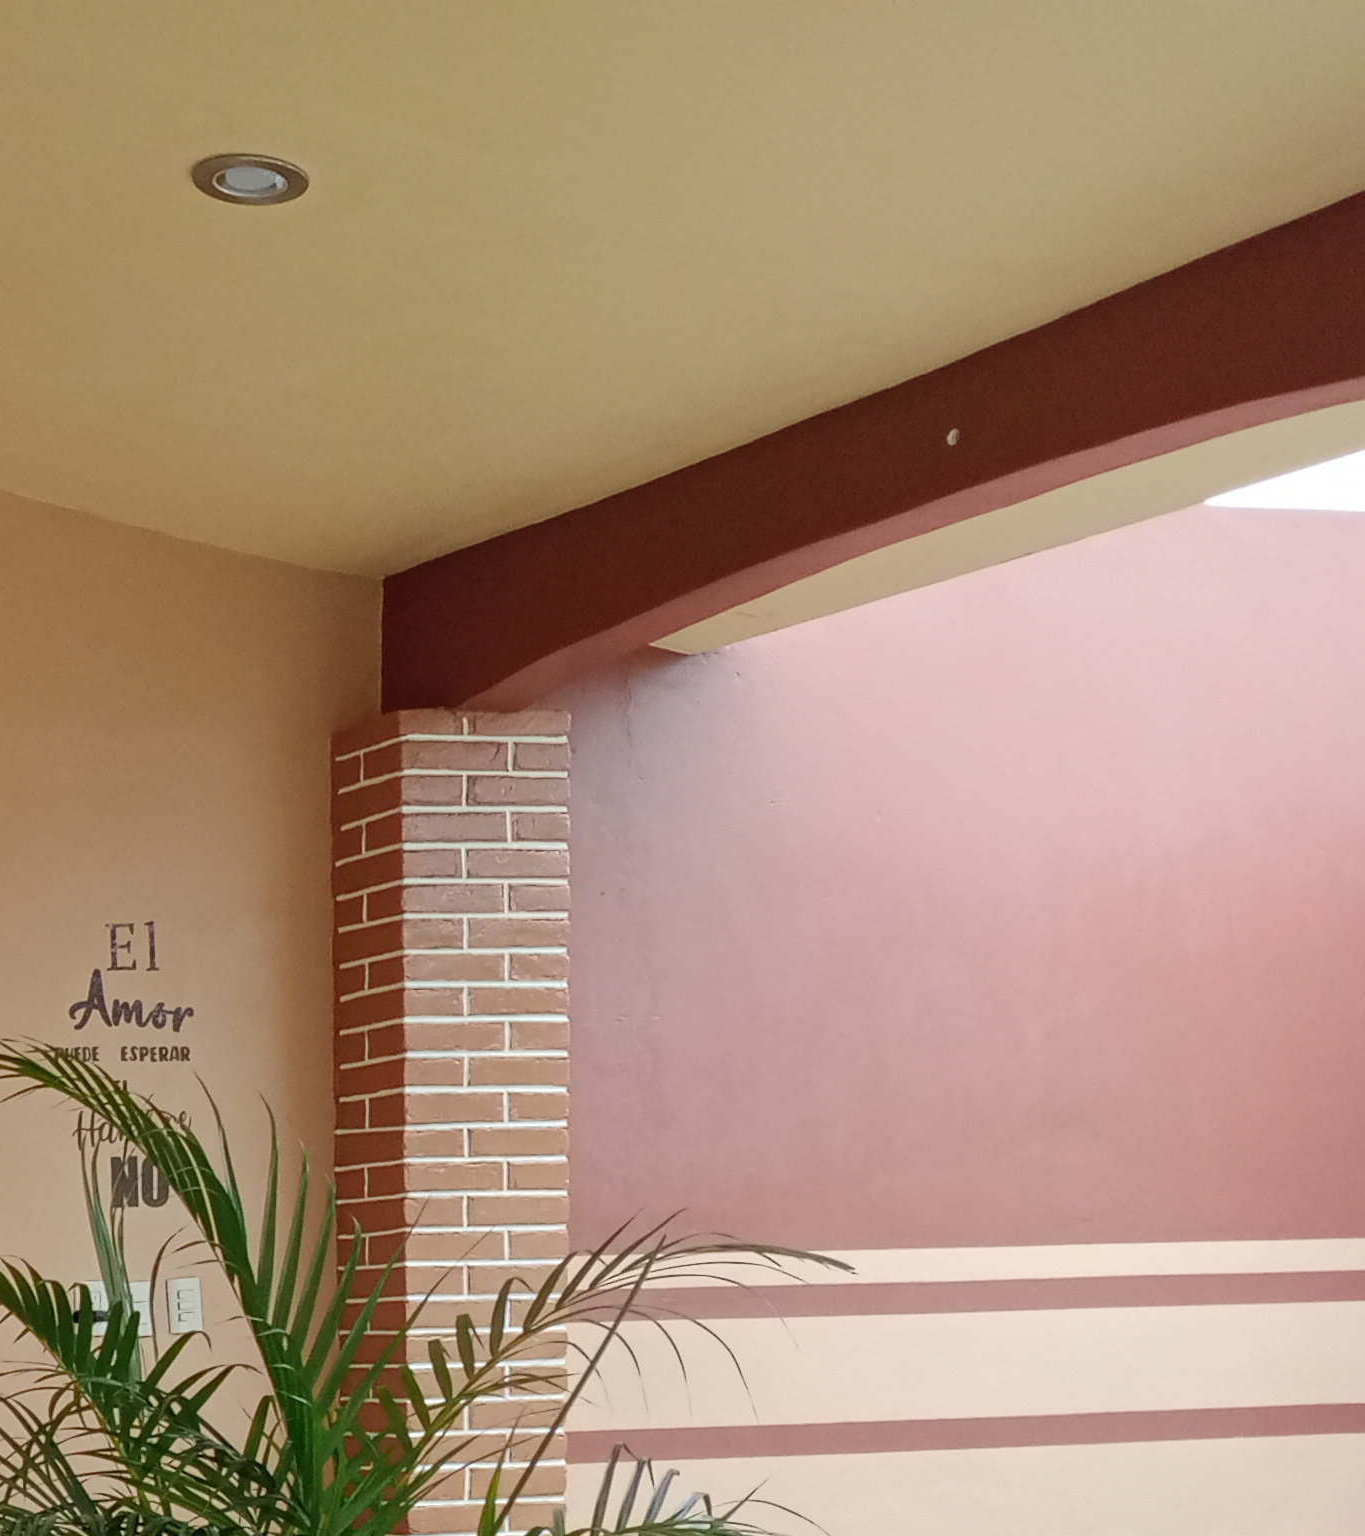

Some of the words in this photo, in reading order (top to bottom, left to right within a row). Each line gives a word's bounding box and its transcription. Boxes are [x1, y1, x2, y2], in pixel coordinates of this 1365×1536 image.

[105, 920, 160, 972] El
[69, 967, 194, 1032] Amor
[120, 1046, 190, 1062] ESPERAR
[110, 1156, 170, 1207] NO
